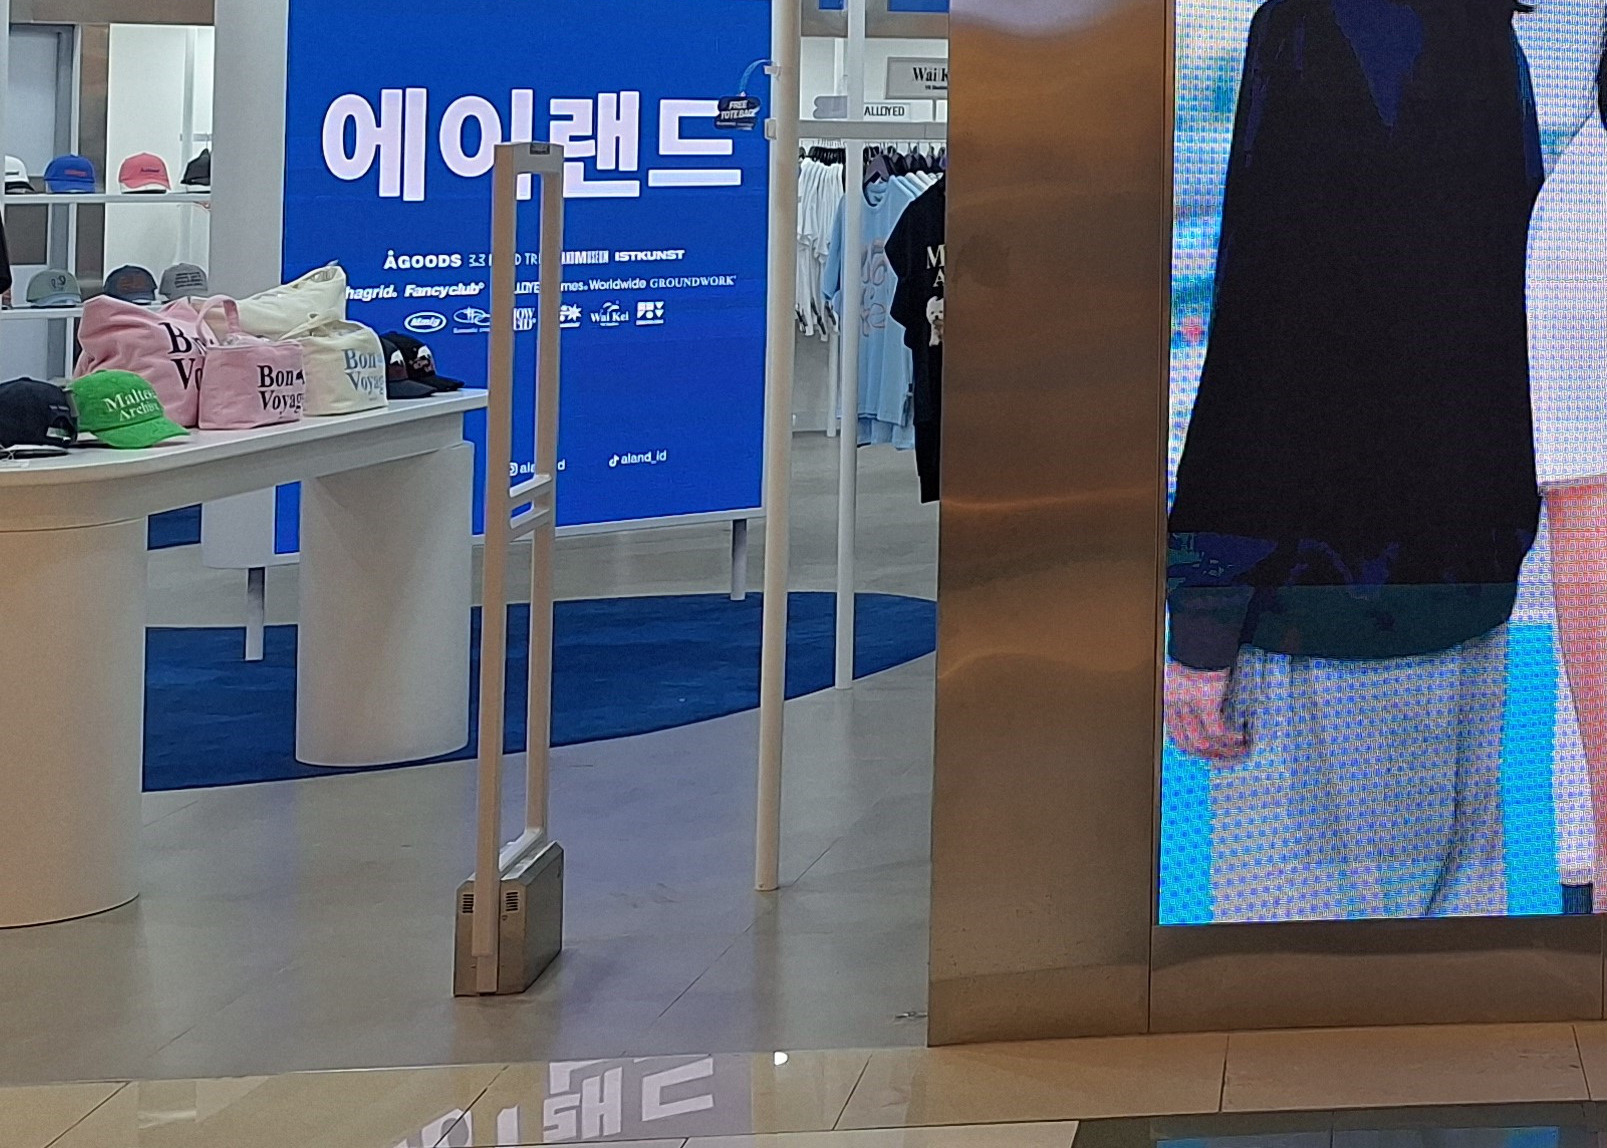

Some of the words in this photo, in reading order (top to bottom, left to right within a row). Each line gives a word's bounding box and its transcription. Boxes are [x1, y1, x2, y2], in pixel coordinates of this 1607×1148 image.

[864, 105, 905, 116] ALLOYED
[322, 87, 742, 202] 에이랜드
[383, 250, 462, 269] ÅGOODS
[614, 250, 685, 262] ISTKUNST
[589, 278, 646, 290] Worldwide
[341, 348, 376, 370] Bon
[257, 365, 294, 388] Bon
[621, 450, 667, 465] aland_id
